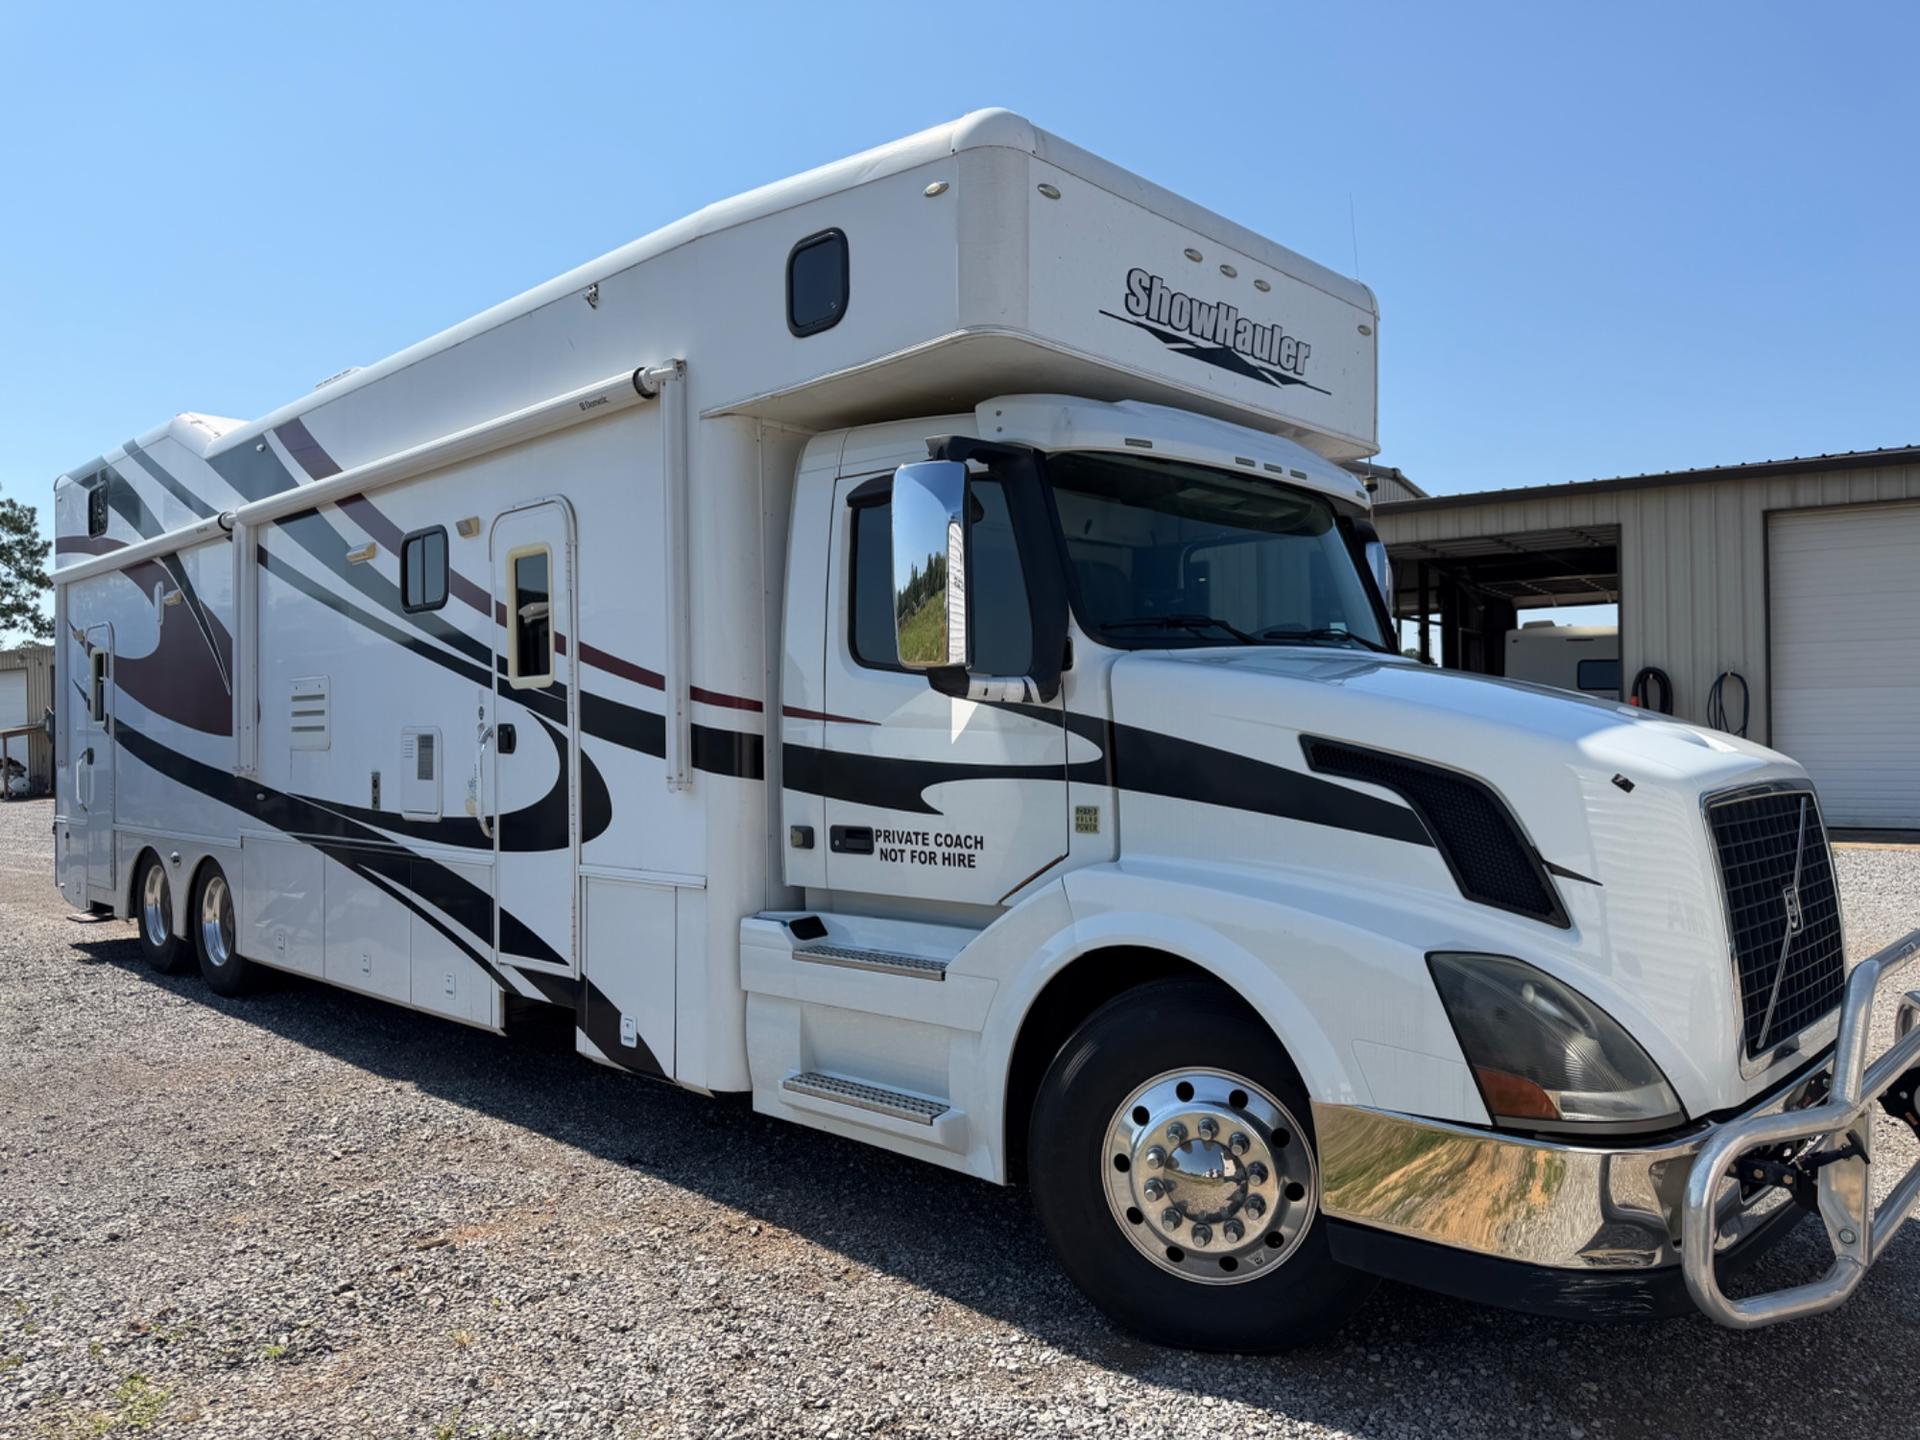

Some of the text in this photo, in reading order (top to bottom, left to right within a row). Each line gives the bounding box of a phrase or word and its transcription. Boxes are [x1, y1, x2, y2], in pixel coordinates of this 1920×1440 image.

[1125, 268, 1311, 375] ShowHauler
[875, 829, 984, 850] PRIVATE COACH
[880, 848, 976, 869] NOT FOR HIRE
